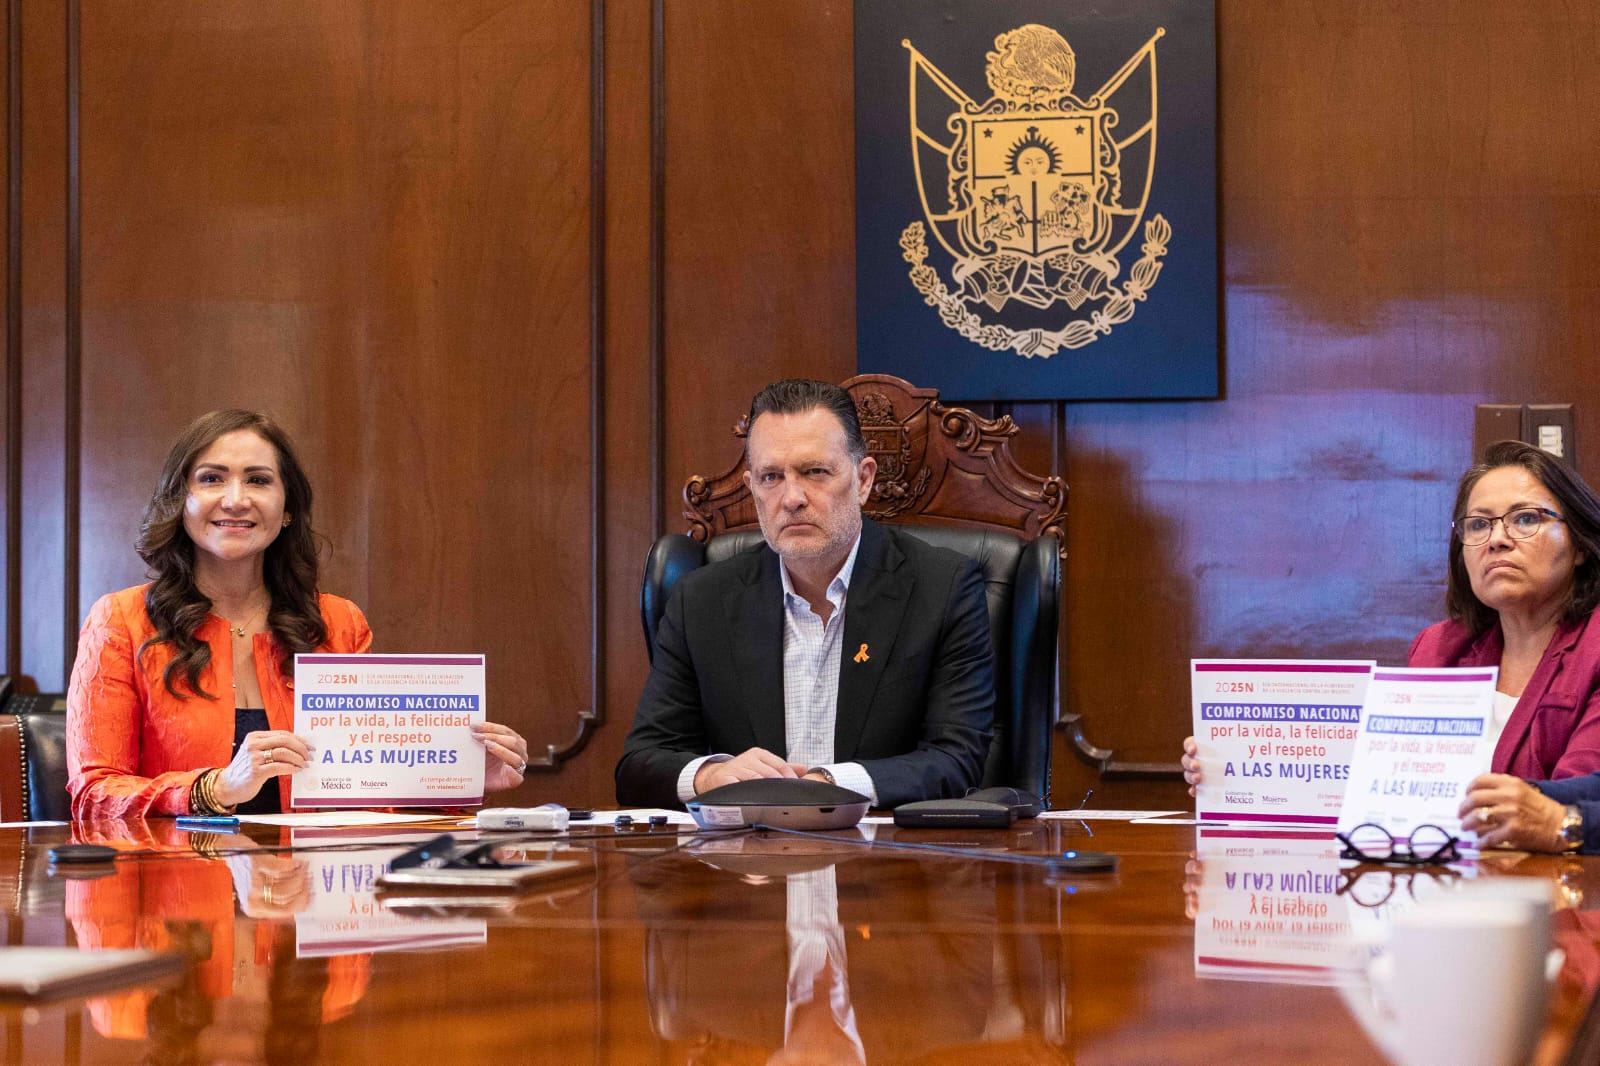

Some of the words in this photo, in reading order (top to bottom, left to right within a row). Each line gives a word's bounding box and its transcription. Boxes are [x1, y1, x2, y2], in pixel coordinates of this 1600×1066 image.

[317, 674, 358, 684] 2025N
[1215, 682, 1254, 693] 2025N
[306, 697, 400, 709] COMPROMISO
[406, 698, 475, 709] NACIONAL
[1206, 706, 1296, 719] COMPROMISO
[310, 716, 335, 730] por
[339, 714, 351, 727] la
[355, 714, 389, 728] vida,
[394, 714, 406, 727] la
[410, 713, 471, 727] felicidad
[1369, 717, 1435, 734] COMPROMISO
[1436, 719, 1482, 734] NACIONAL
[349, 733, 358, 747] y
[361, 730, 374, 743] el
[378, 731, 432, 746] respeto
[1211, 726, 1233, 741] por
[1238, 724, 1249, 737] la
[1253, 724, 1286, 739] vida,
[1290, 725, 1301, 738] la
[322, 750, 334, 764] A
[341, 750, 373, 764] LAS
[381, 750, 458, 768] MUJERES
[1248, 745, 1256, 759] y
[1260, 742, 1272, 756] el
[1275, 744, 1326, 759] respeto
[1224, 762, 1236, 777] A
[1242, 762, 1273, 777] LAS
[1279, 763, 1350, 782] MUJERES
[320, 781, 352, 790] México
[360, 780, 388, 788] Mujeres
[1369, 779, 1378, 794] A
[1383, 780, 1406, 796] LAS
[1409, 781, 1458, 801] MUJERES
